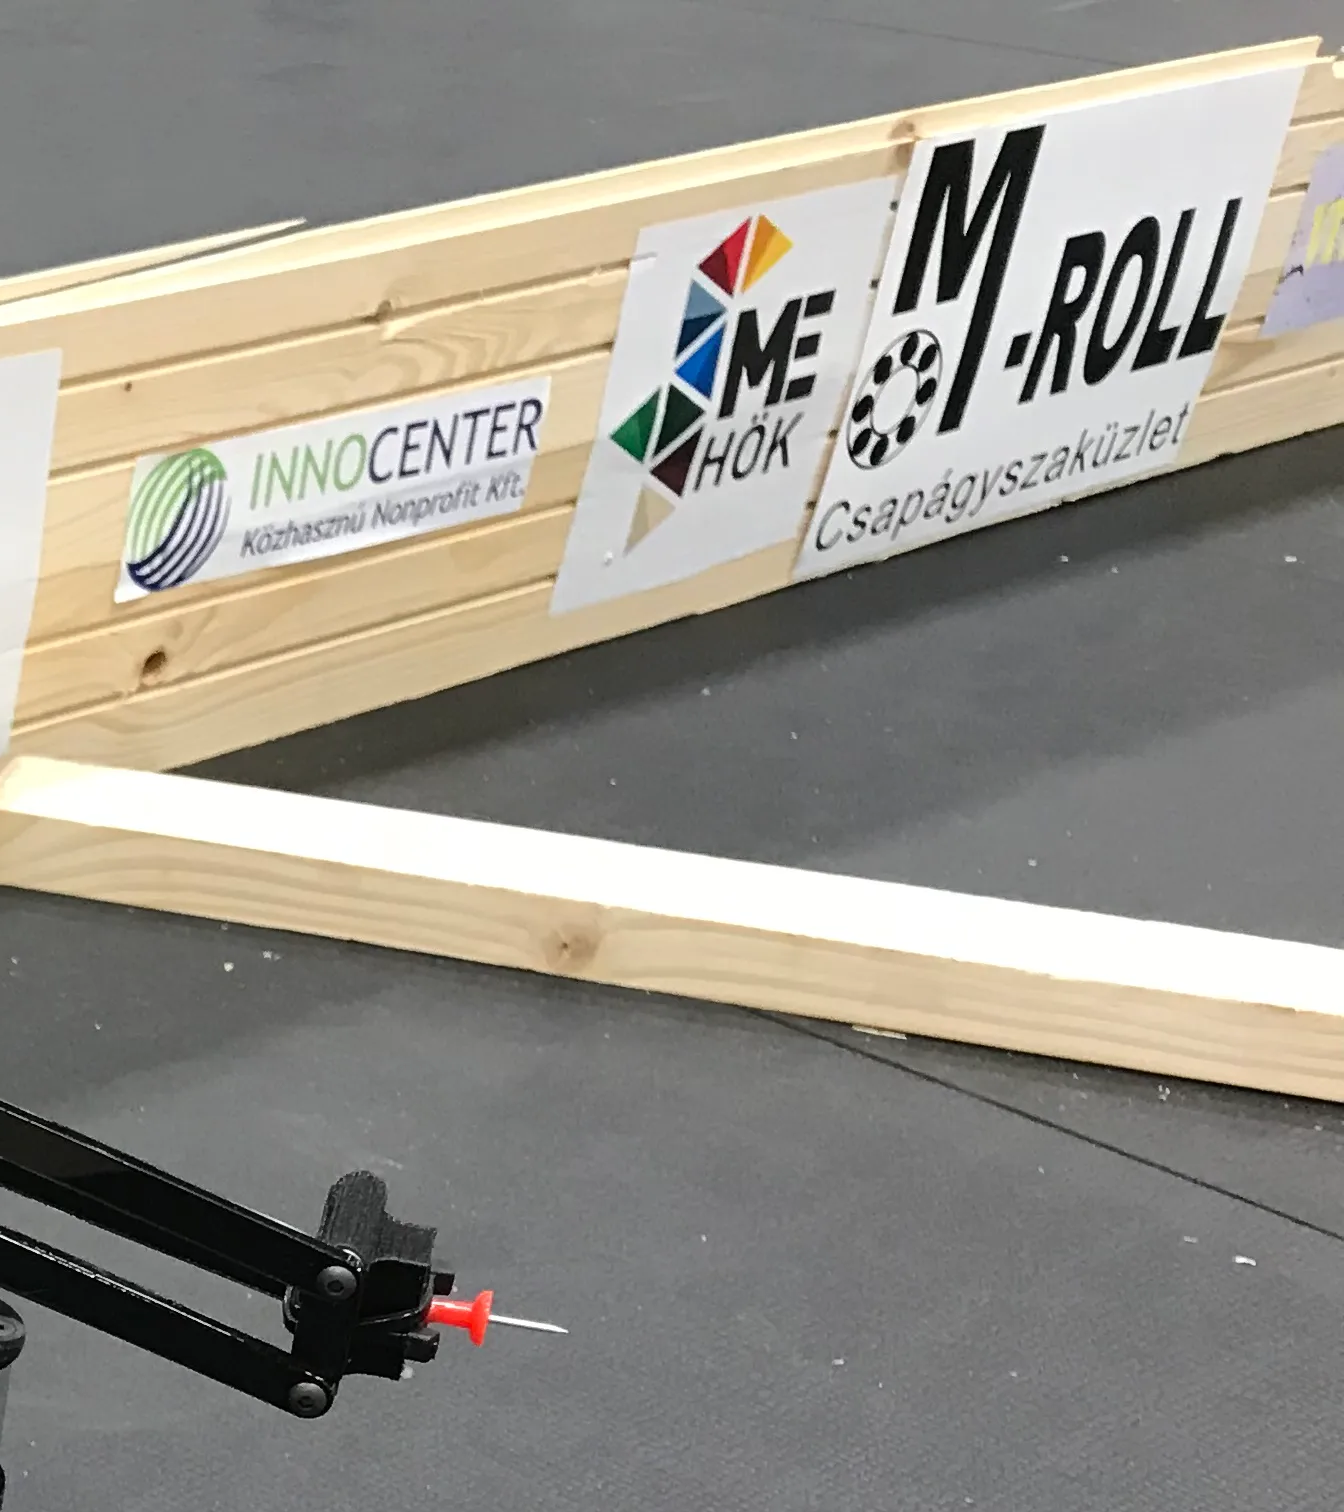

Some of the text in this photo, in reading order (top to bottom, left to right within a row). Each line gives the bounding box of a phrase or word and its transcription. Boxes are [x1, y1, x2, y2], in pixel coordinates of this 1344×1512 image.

[717, 288, 836, 420] ME
[249, 397, 543, 511] INNOCENTER
[371, 480, 481, 527] Nonprofit
[486, 471, 526, 502] Kft.
[693, 411, 805, 492] HÖK
[815, 401, 1189, 552] Csapágyszaküzlet
